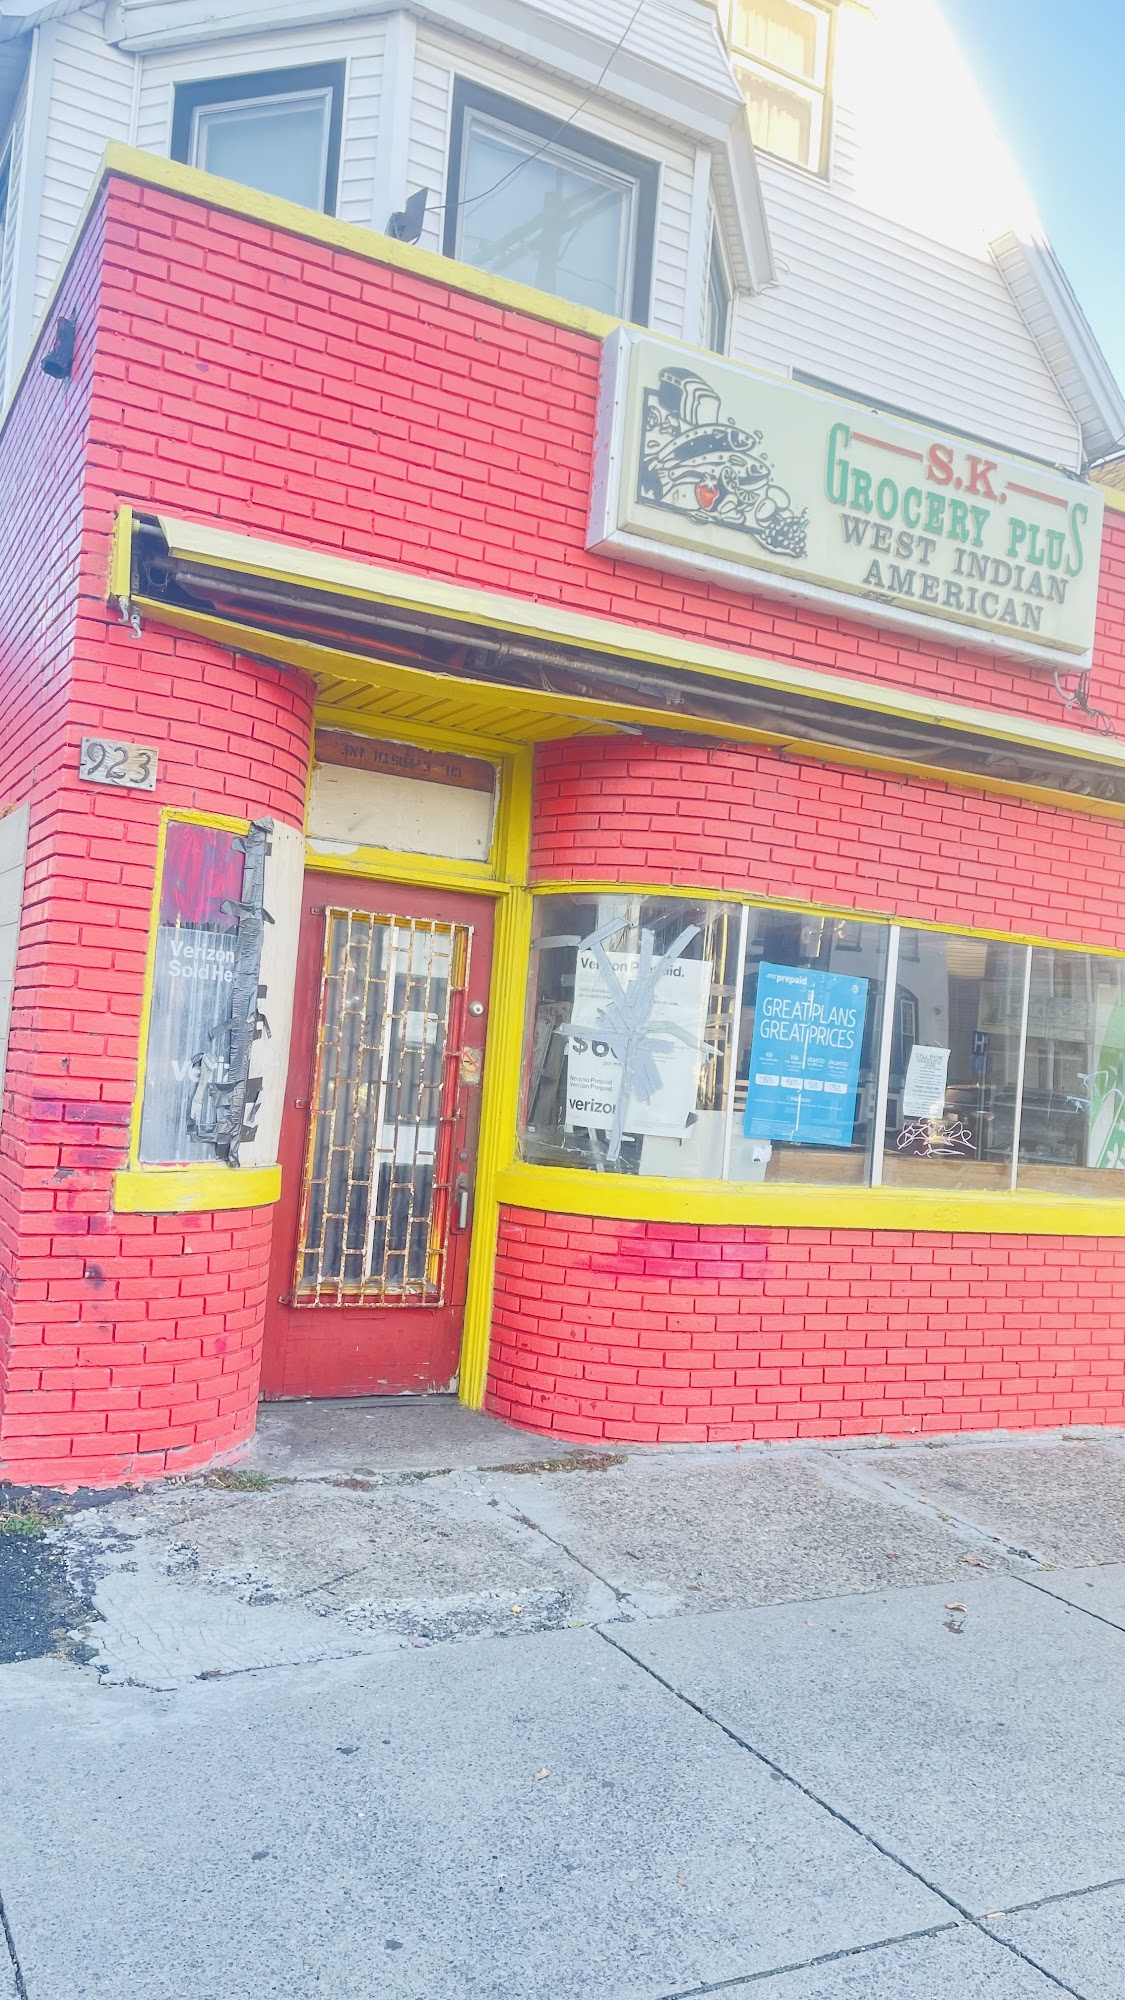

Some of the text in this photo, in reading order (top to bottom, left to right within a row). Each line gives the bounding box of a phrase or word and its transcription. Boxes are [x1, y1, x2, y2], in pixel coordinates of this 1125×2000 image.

[926, 442, 1007, 504] S.K.
[826, 421, 1088, 577] GROCERY PLUS
[840, 512, 1069, 605] WEST INDIAN
[863, 558, 1044, 632] AMERICAN
[85, 742, 152, 784] 923
[168, 959, 209, 980] Sold
[170, 940, 235, 963] Verizon
[762, 997, 857, 1028] GREAT PLANS
[760, 1018, 855, 1049] GREAT PRICES
[570, 1081, 589, 1089] Verizon
